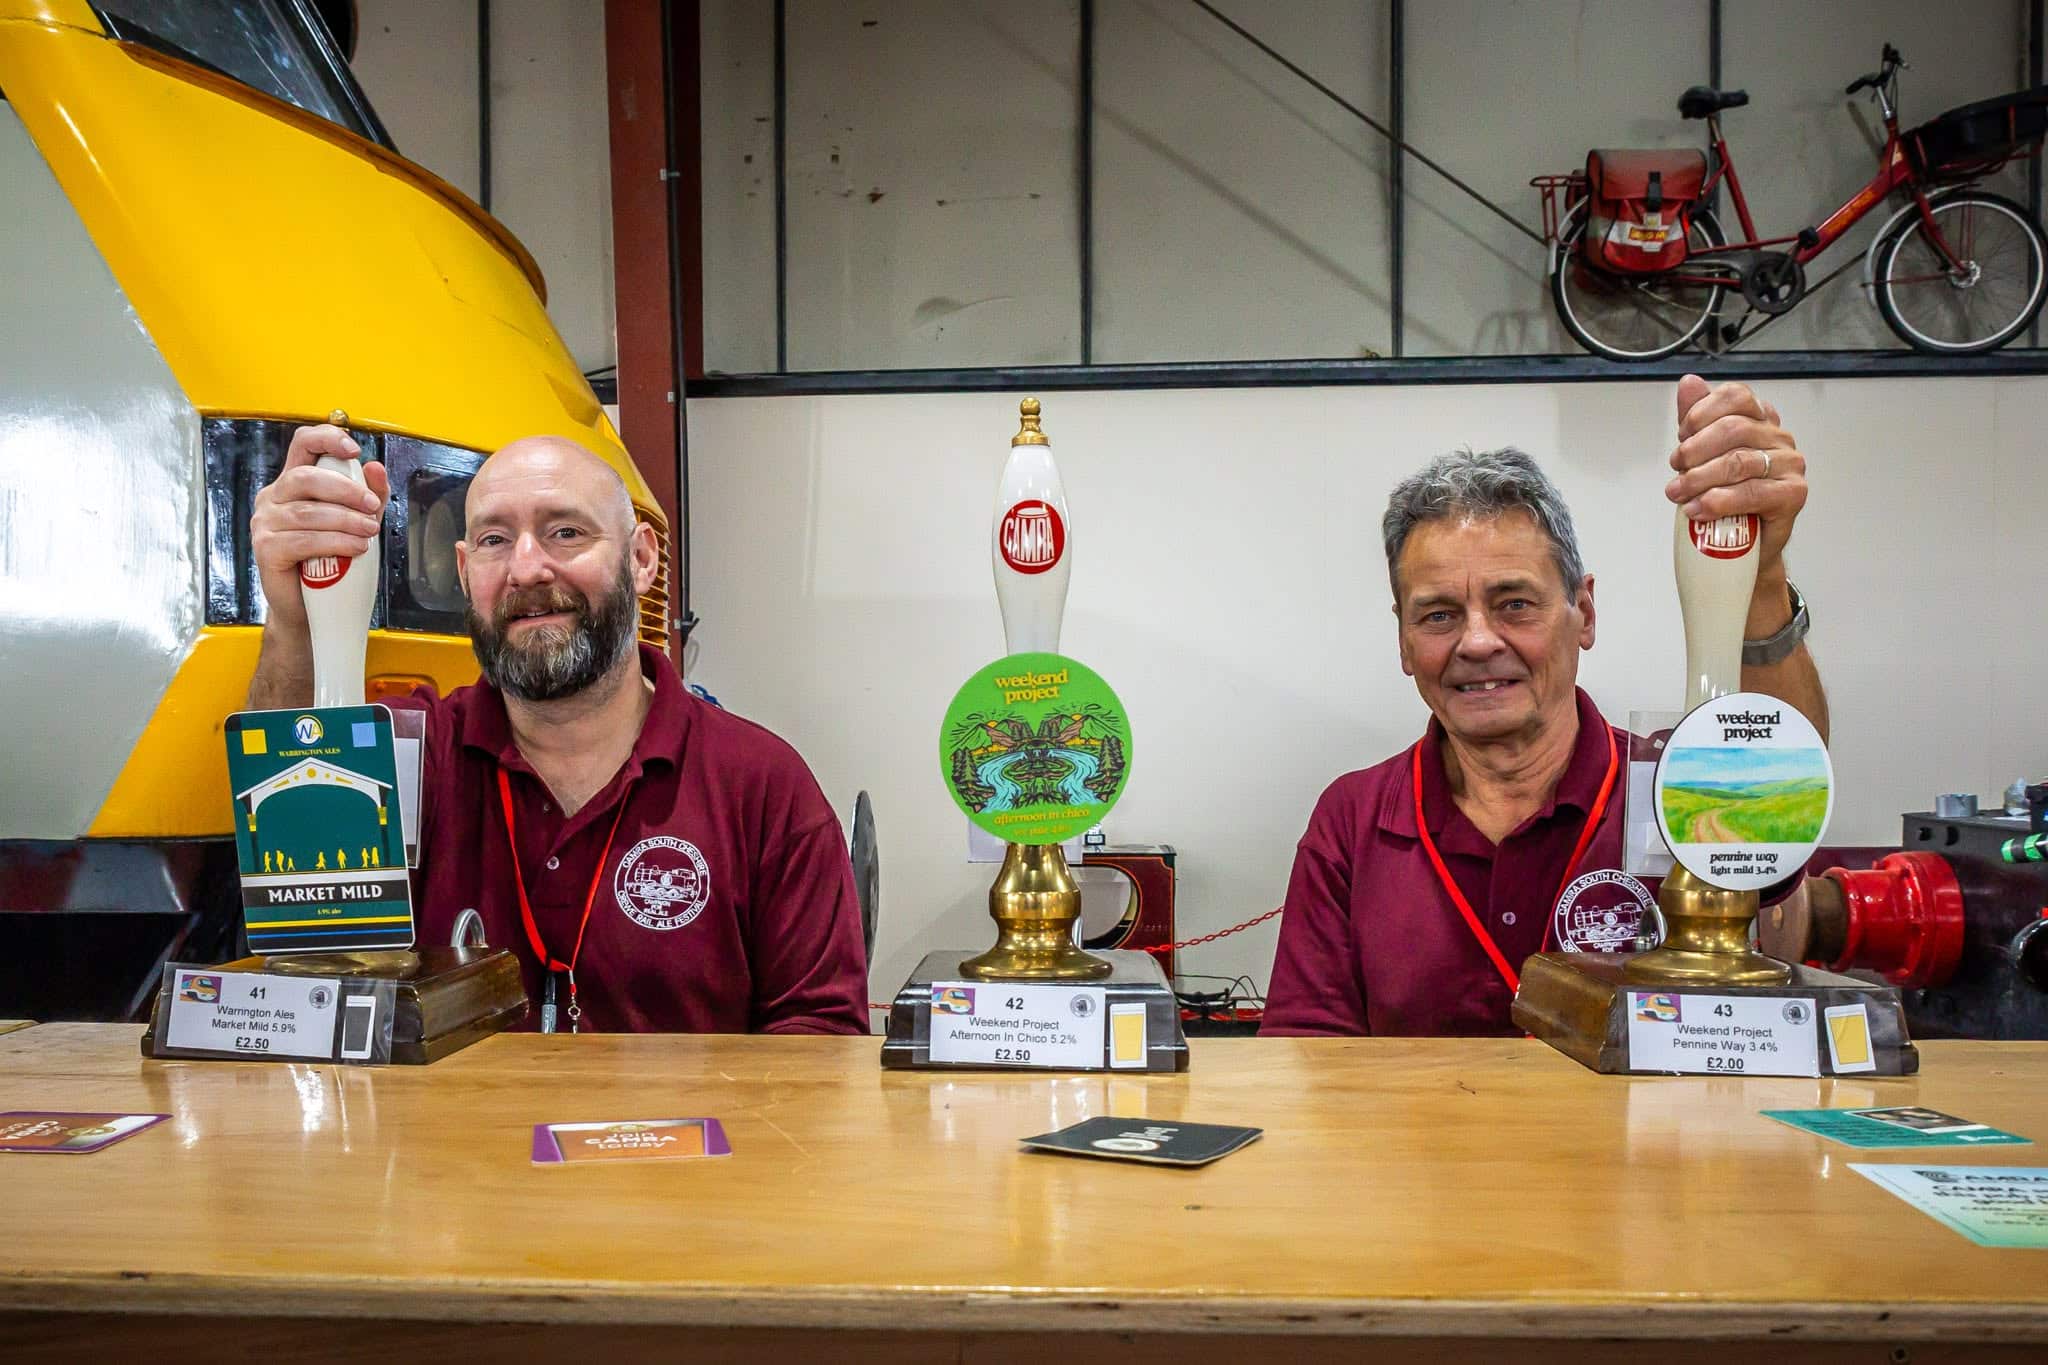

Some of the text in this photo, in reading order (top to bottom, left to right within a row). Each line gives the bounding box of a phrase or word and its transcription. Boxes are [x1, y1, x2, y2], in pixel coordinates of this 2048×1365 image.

[1003, 517, 1055, 562] CAMRA
[994, 668, 1069, 688] weekend
[1004, 686, 1060, 704] project
[1716, 710, 1781, 725] weekend
[1723, 725, 1773, 742] project
[648, 838, 678, 848] SOUTH
[1709, 850, 1779, 864] pennine way
[1710, 865, 1778, 875] light mild 3.4%
[268, 884, 383, 903] MARKET MILD
[1579, 872, 1610, 888] SOUTH
[1612, 873, 1653, 906] CHESHIRE
[636, 914, 654, 927] RAIL
[656, 919, 673, 928] ALE
[249, 986, 267, 1000] 41
[1005, 997, 1024, 1010] 42
[1713, 1003, 1734, 1017] 43
[216, 1005, 295, 1019] Warrington Ales
[211, 1020, 296, 1034] Market Mild 5.9%
[969, 1016, 1060, 1032] Weekend Project
[949, 1030, 1077, 1045] Afternoon In Chico 5.2%
[1677, 1024, 1773, 1039] Weekend Project
[235, 1036, 270, 1050] £2.50
[1672, 1038, 1778, 1053] Pennine Way 3.4%
[994, 1049, 1031, 1062] £2.50
[1706, 1057, 1744, 1070] £2.00
[585, 1135, 678, 1145] CAMRA
